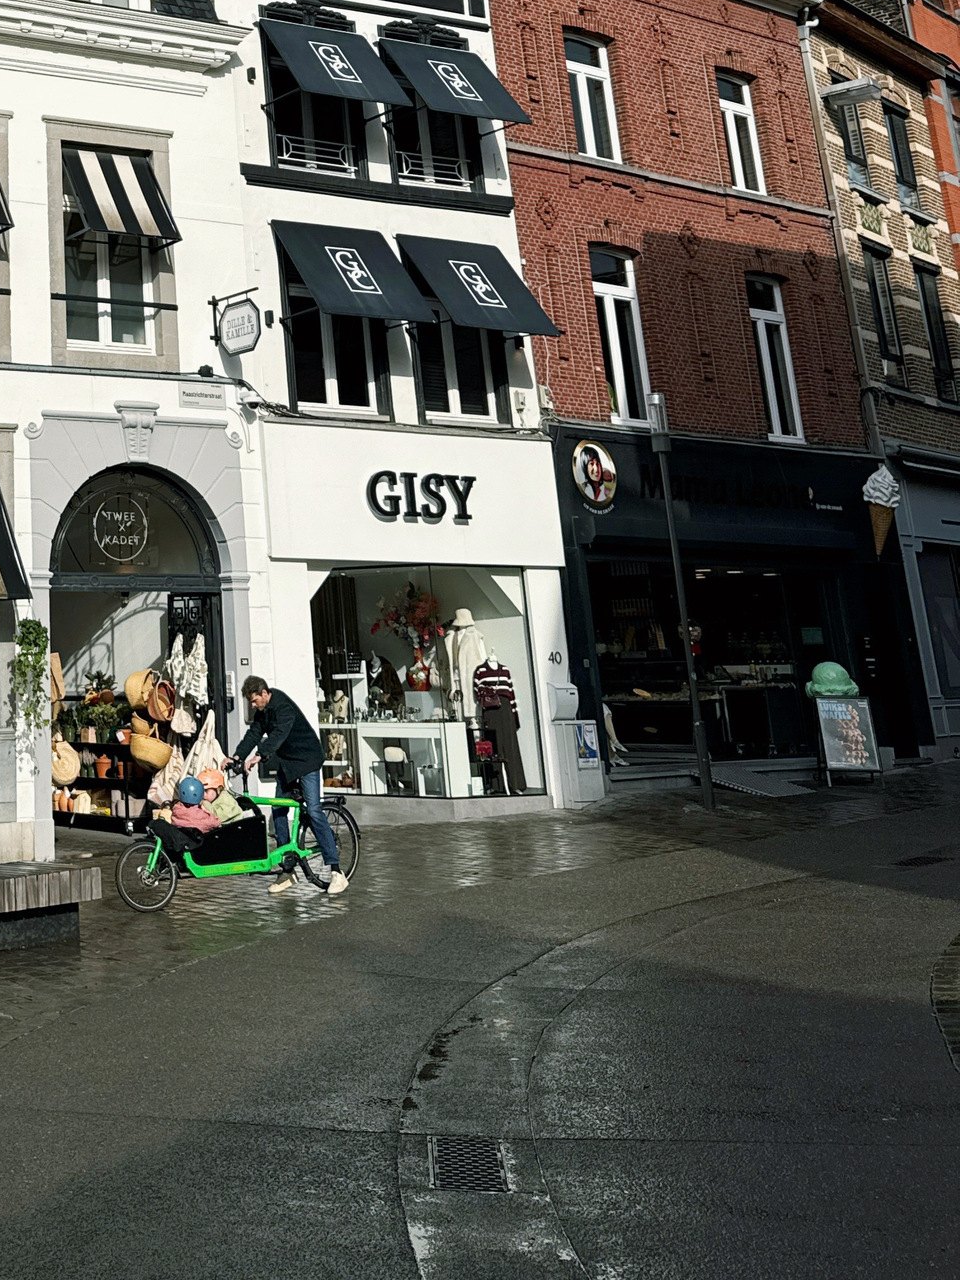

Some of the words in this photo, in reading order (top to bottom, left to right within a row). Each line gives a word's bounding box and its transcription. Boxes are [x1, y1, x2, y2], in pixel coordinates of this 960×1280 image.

[227, 316, 245, 329] DILLE
[247, 314, 252, 323] &
[226, 324, 255, 340] KAMILLE
[366, 470, 477, 525] GISY
[106, 511, 136, 521] TWEE
[105, 535, 140, 546] KADET
[548, 651, 562, 664] 40
[821, 711, 852, 720] WAFELS
